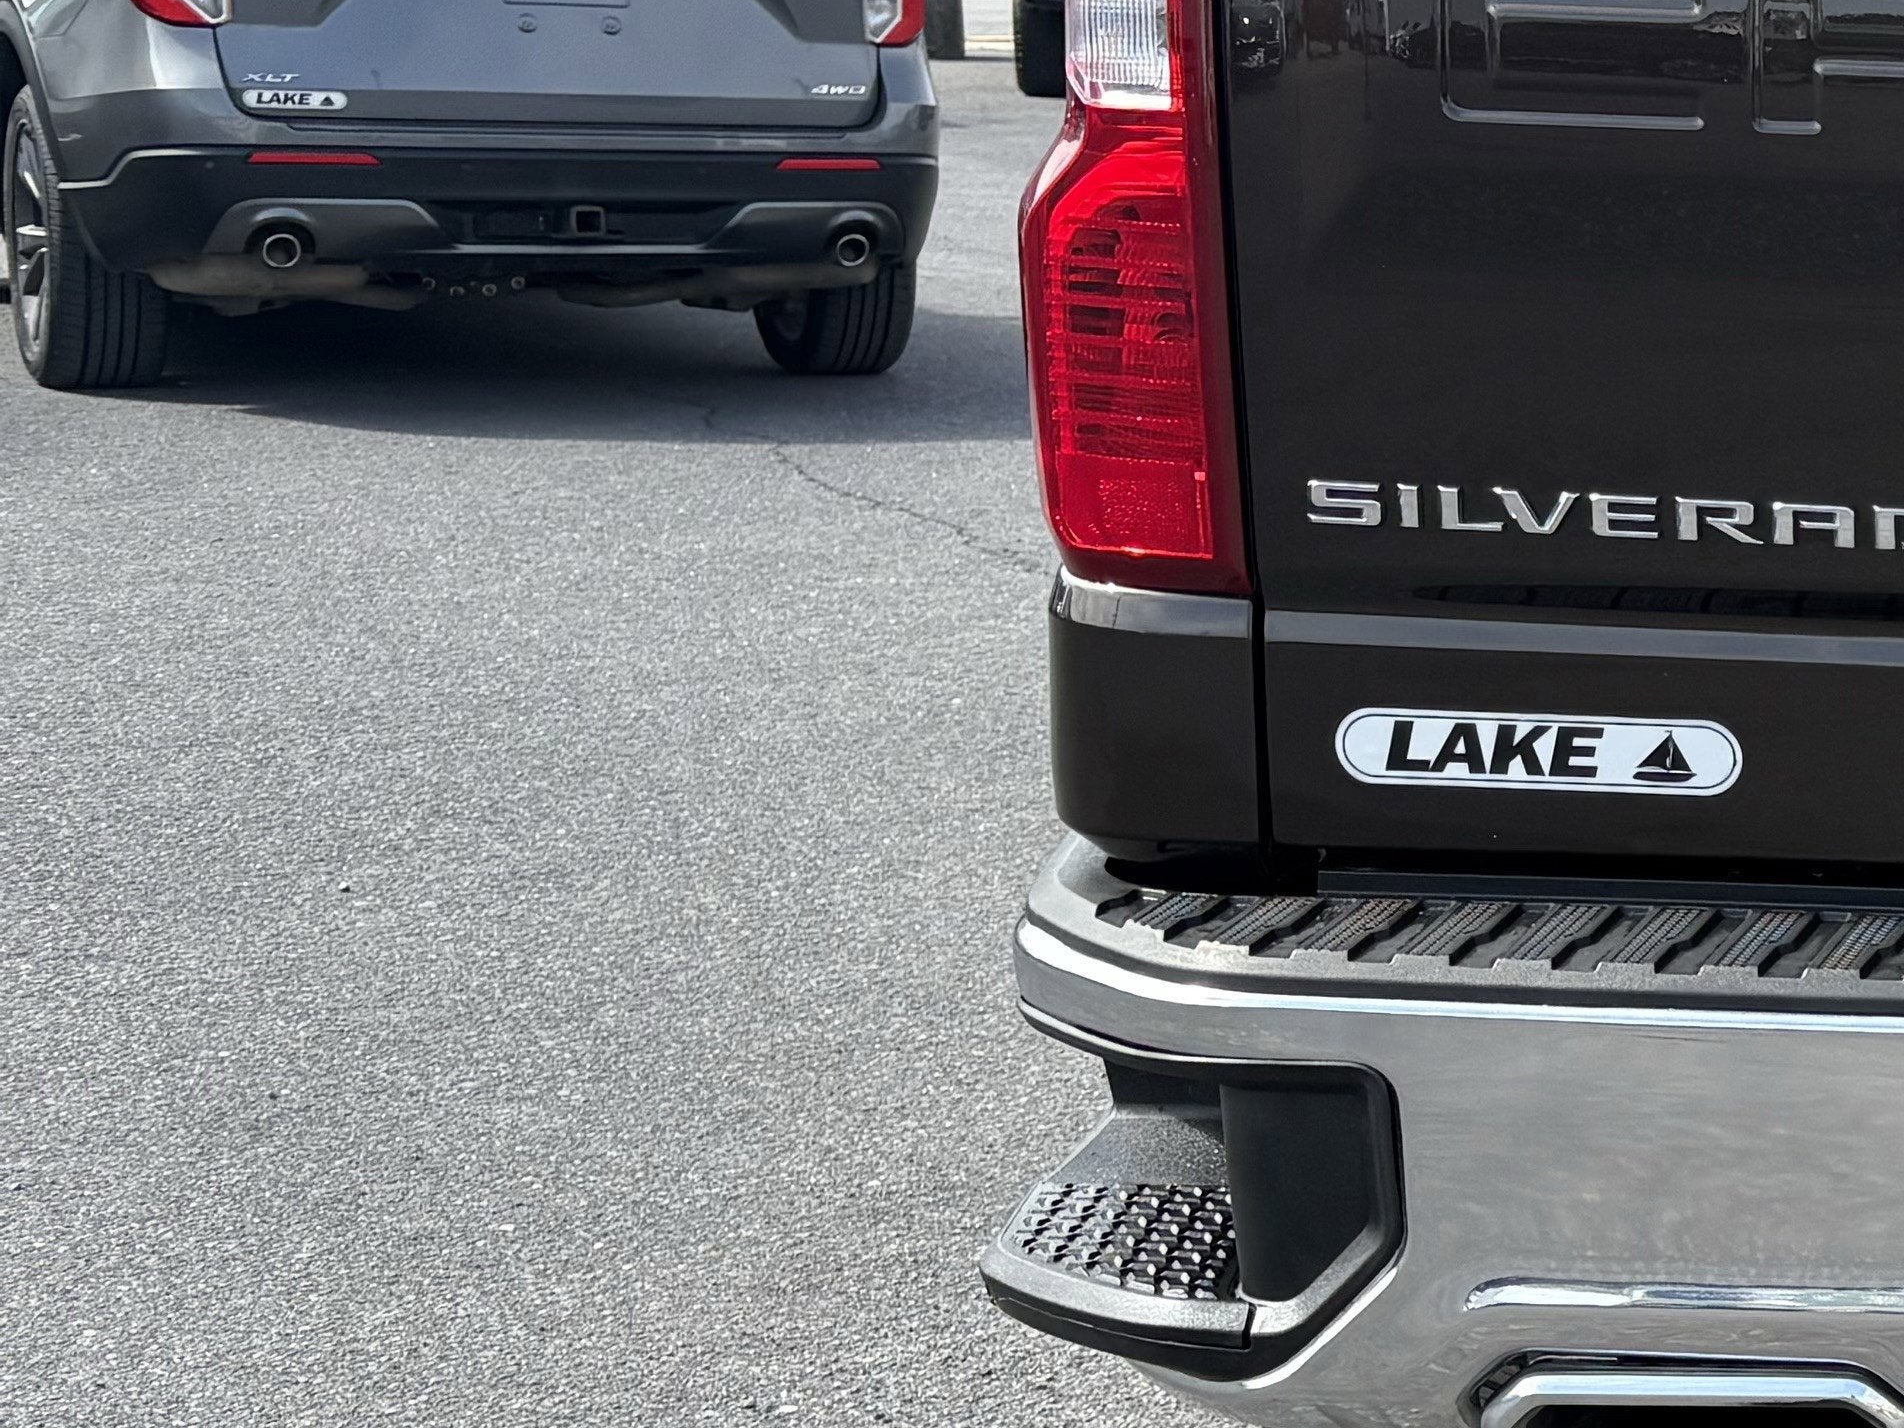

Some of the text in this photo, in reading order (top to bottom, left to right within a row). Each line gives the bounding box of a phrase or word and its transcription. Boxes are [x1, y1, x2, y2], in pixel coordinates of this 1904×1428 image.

[241, 72, 300, 83] XLT
[810, 83, 866, 95] 4WD
[256, 91, 312, 106] LAKE
[1385, 719, 1605, 778] LAKE
